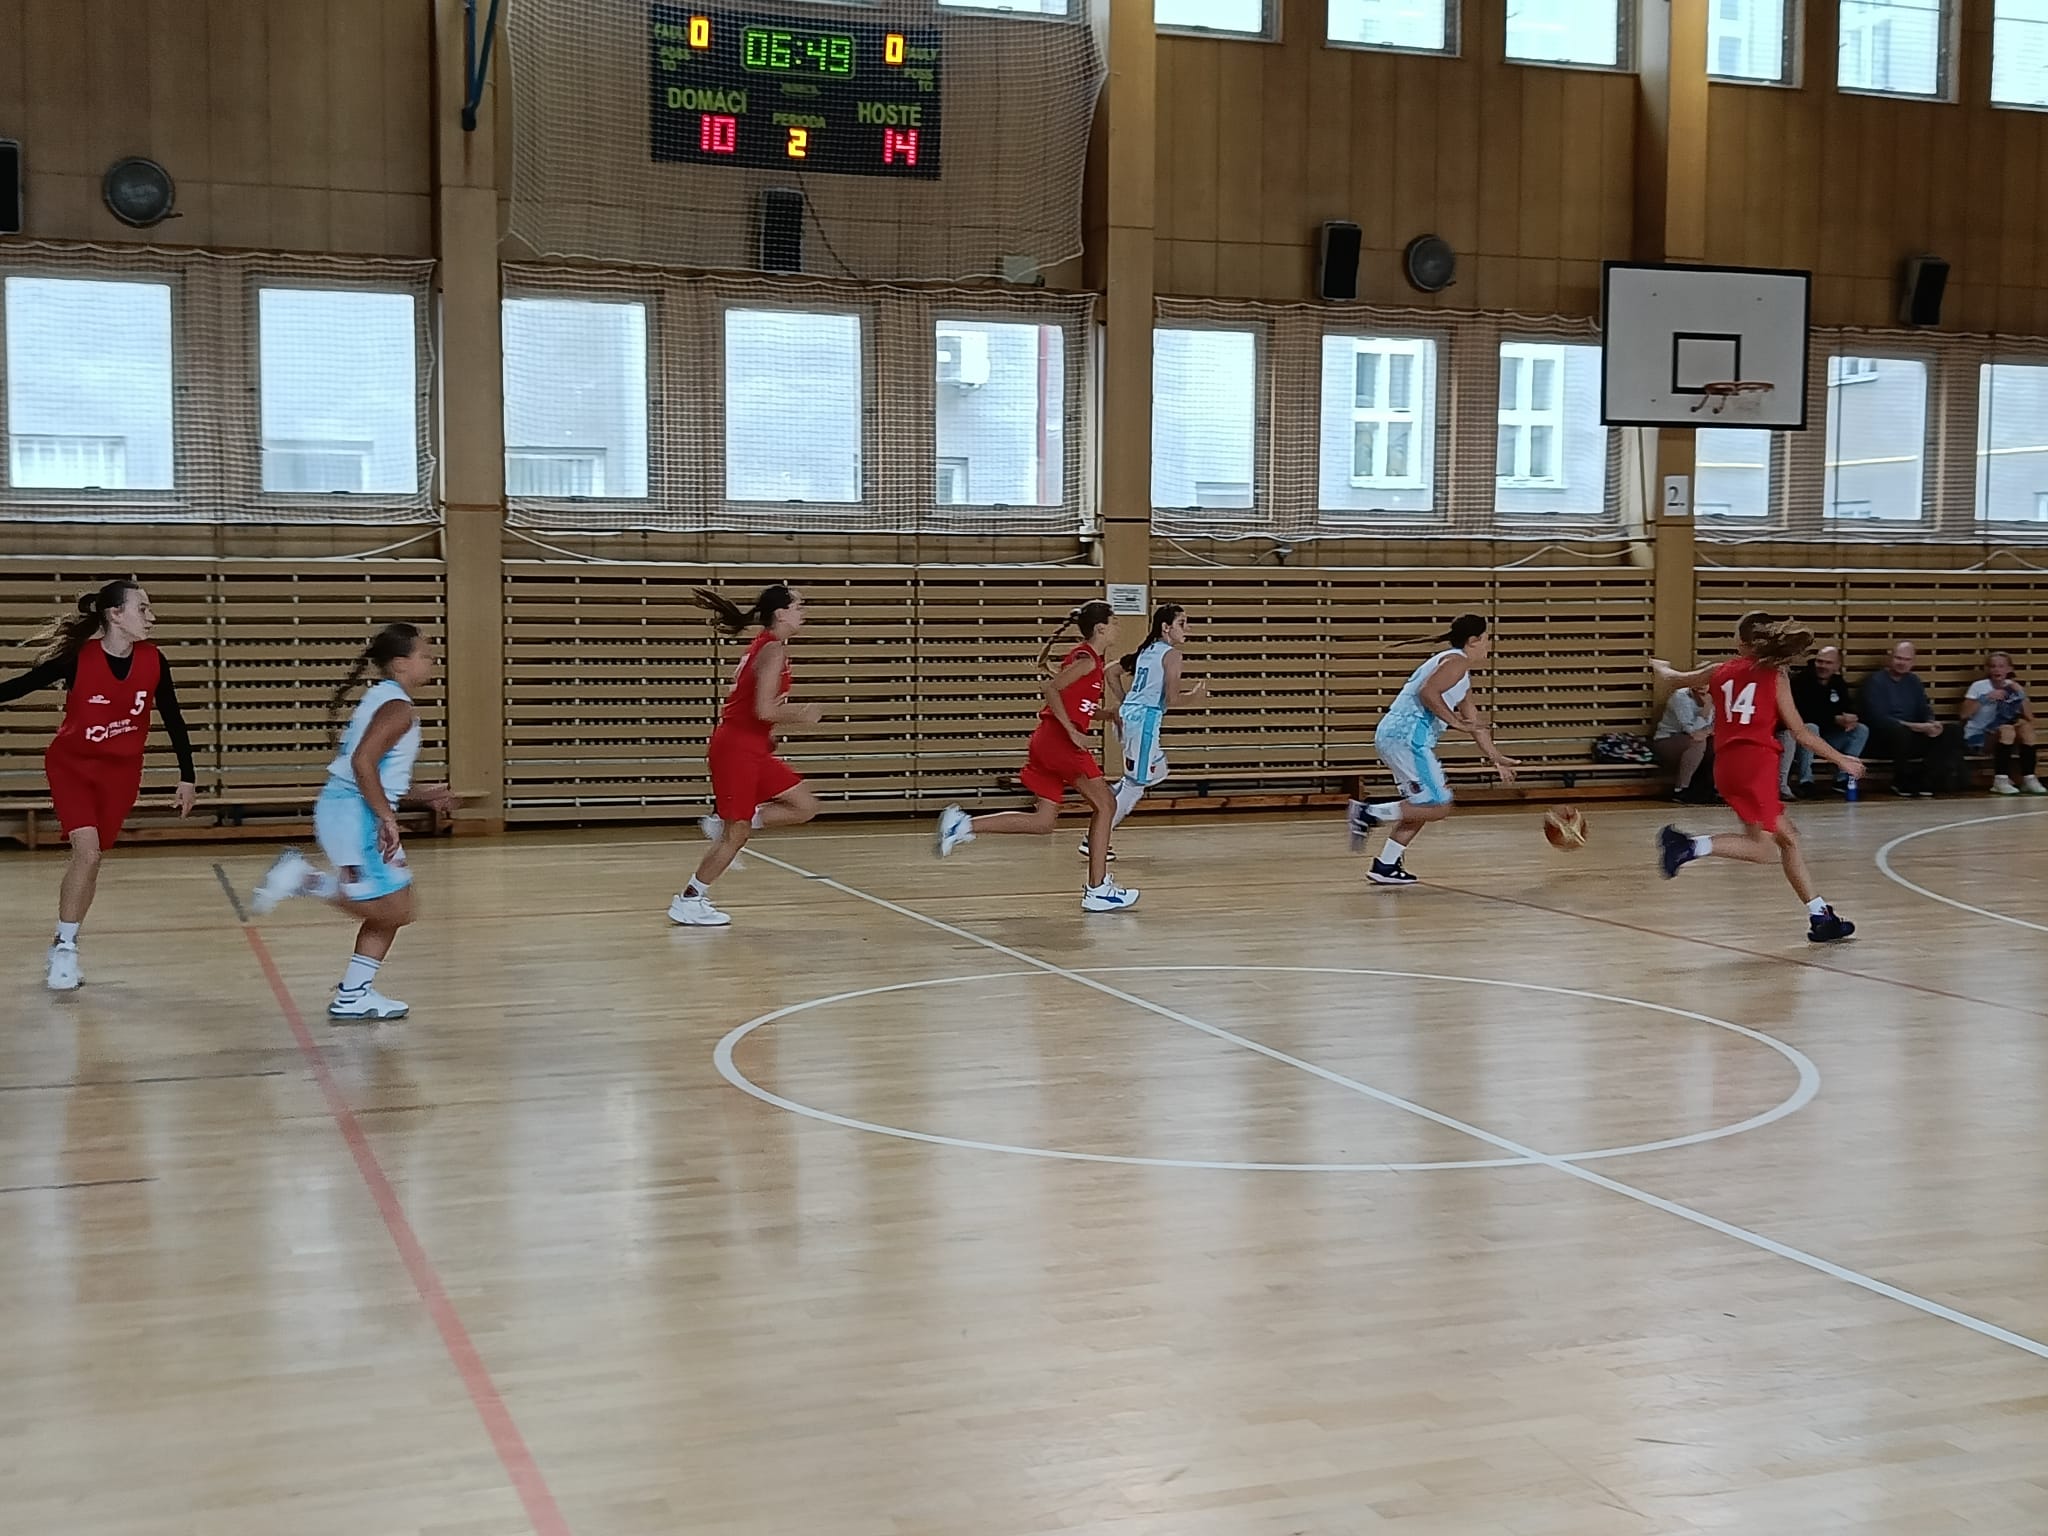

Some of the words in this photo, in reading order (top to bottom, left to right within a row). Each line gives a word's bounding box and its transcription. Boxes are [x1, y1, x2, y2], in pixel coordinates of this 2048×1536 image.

[691, 17, 709, 47] 0
[747, 32, 850, 72] 06:49
[885, 34, 904, 64] 0
[702, 115, 735, 151] 10
[788, 127, 807, 157] 2
[884, 129, 917, 164] 14
[130, 691, 147, 715] 5
[1721, 680, 1757, 724] 14
